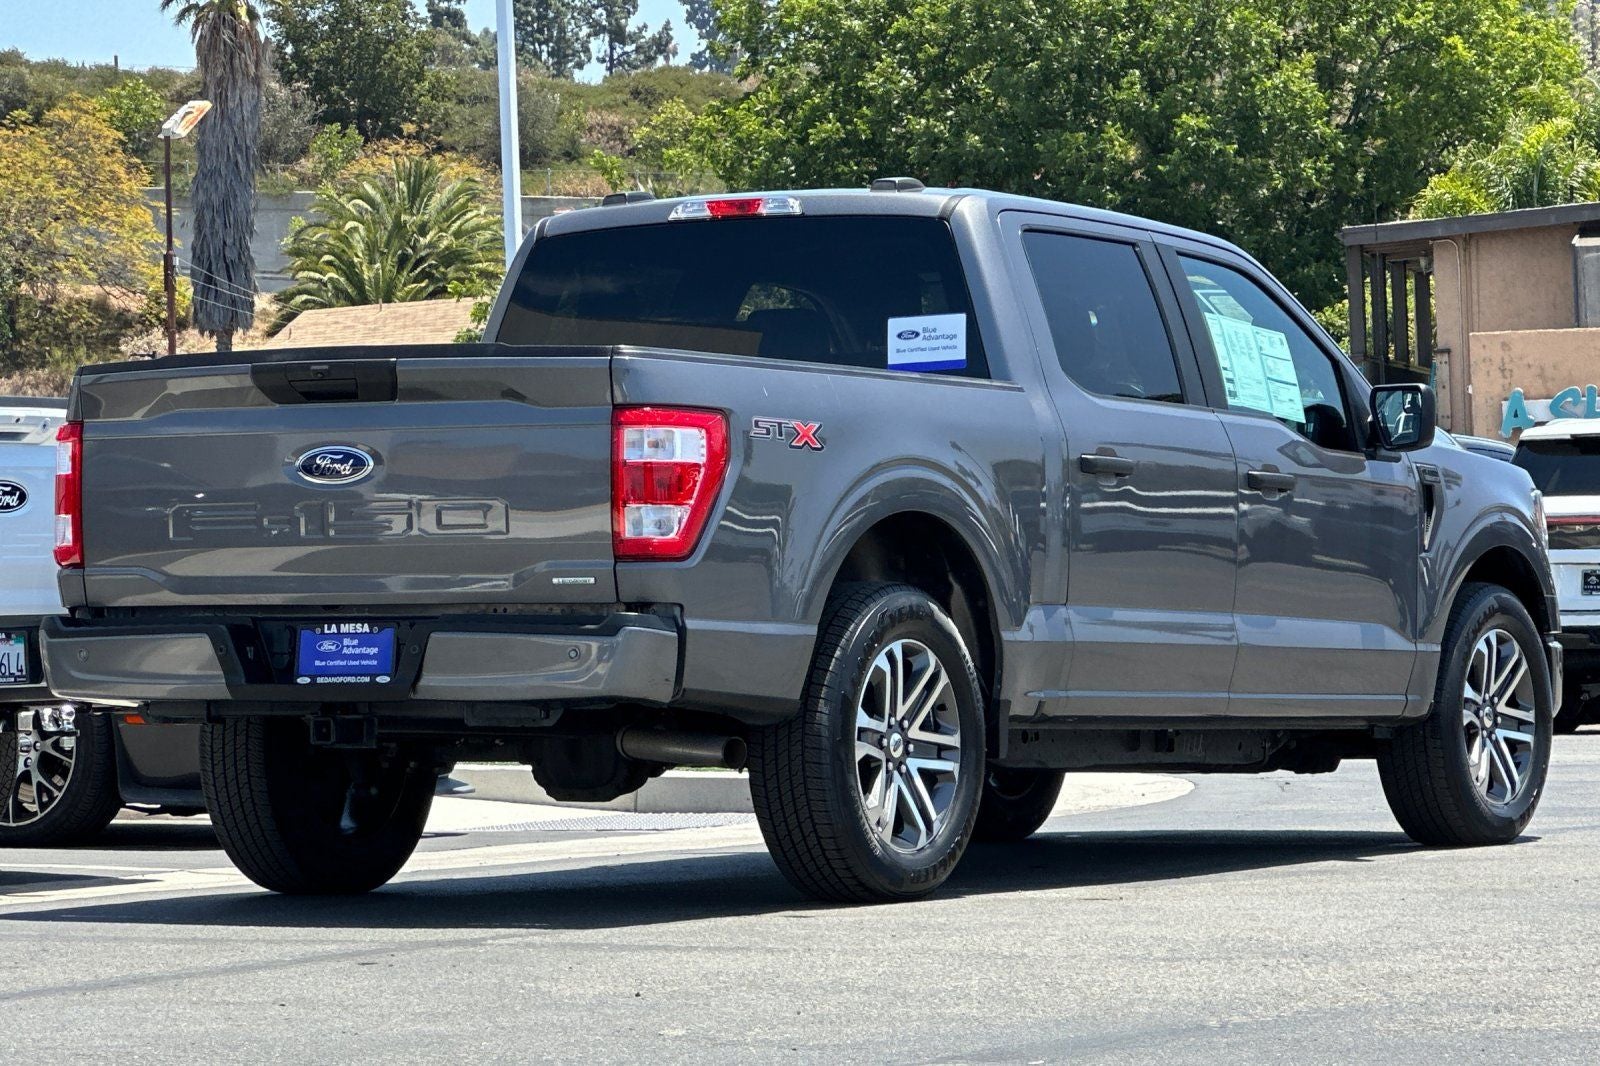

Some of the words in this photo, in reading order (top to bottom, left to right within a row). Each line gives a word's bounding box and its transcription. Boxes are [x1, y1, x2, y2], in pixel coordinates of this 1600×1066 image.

[922, 333, 958, 341] Advantage
[1498, 387, 1534, 438] A
[750, 416, 825, 452] STX
[312, 453, 354, 475] Ford
[168, 497, 510, 541] F-150
[324, 624, 337, 633] LA
[340, 623, 370, 633] MESA
[343, 638, 358, 646] Blue
[342, 646, 378, 655] Advantage
